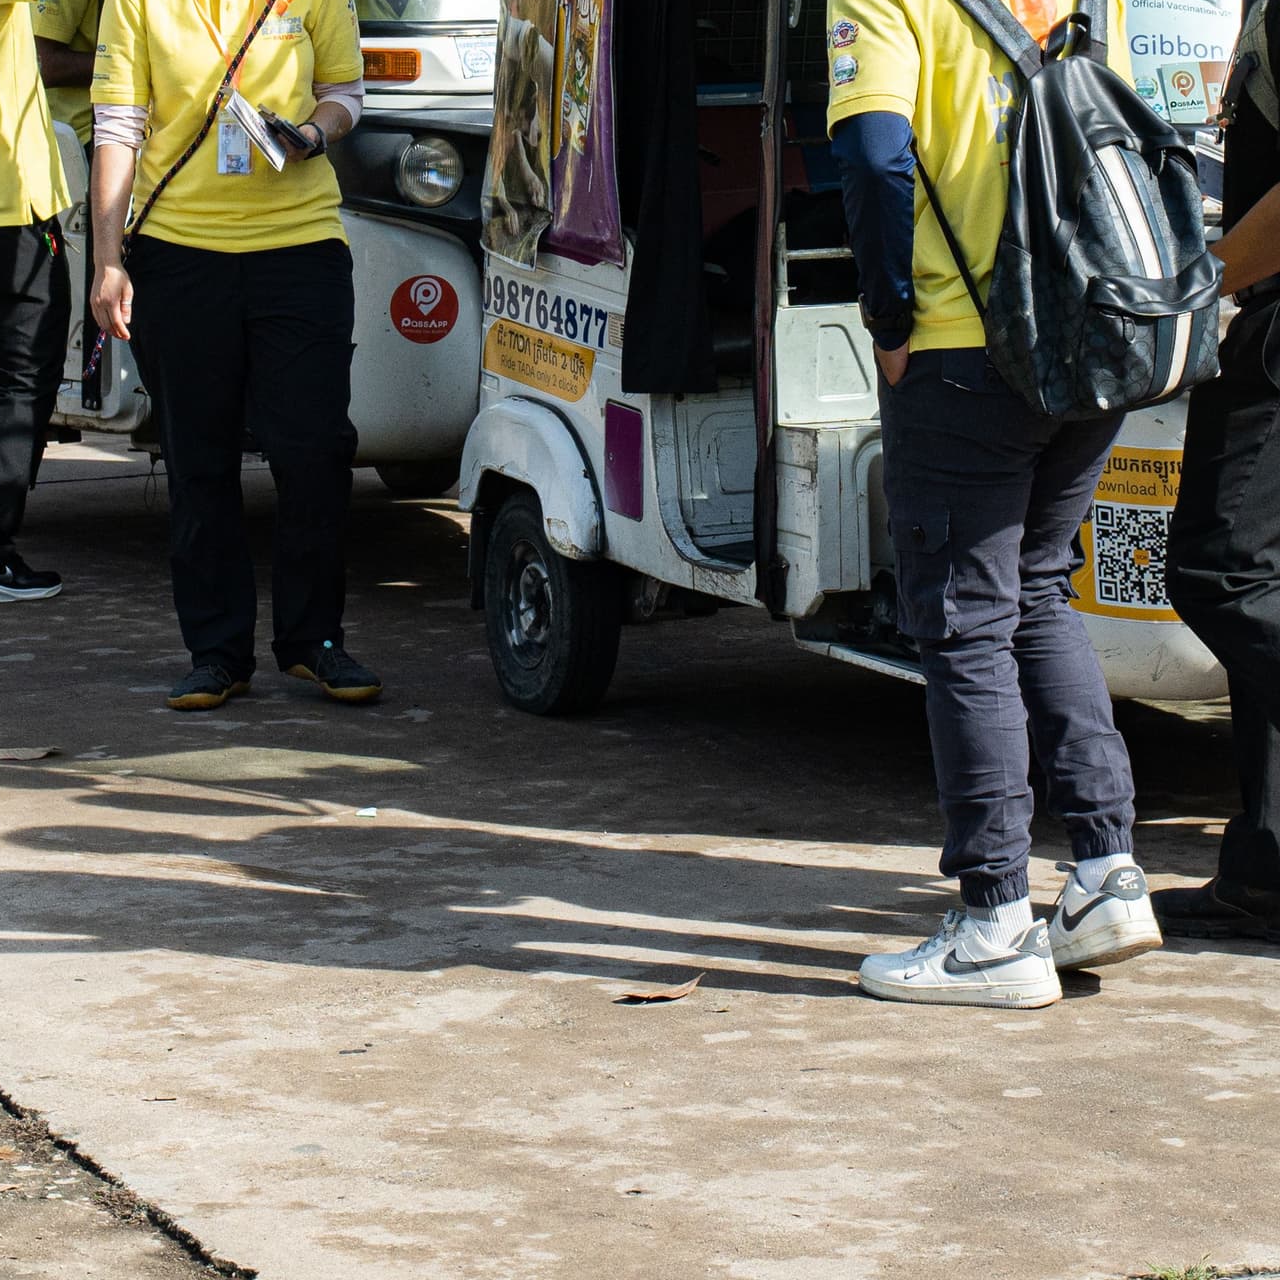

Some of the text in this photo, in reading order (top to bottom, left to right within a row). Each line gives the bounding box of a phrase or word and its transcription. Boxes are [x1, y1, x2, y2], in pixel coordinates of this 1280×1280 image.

[1131, 0, 1165, 9] Official
[1166, 2, 1218, 17] Vaccination
[483, 276, 608, 349] 098764877
[517, 360, 535, 378] TADA
[1098, 480, 1157, 497] ownload
